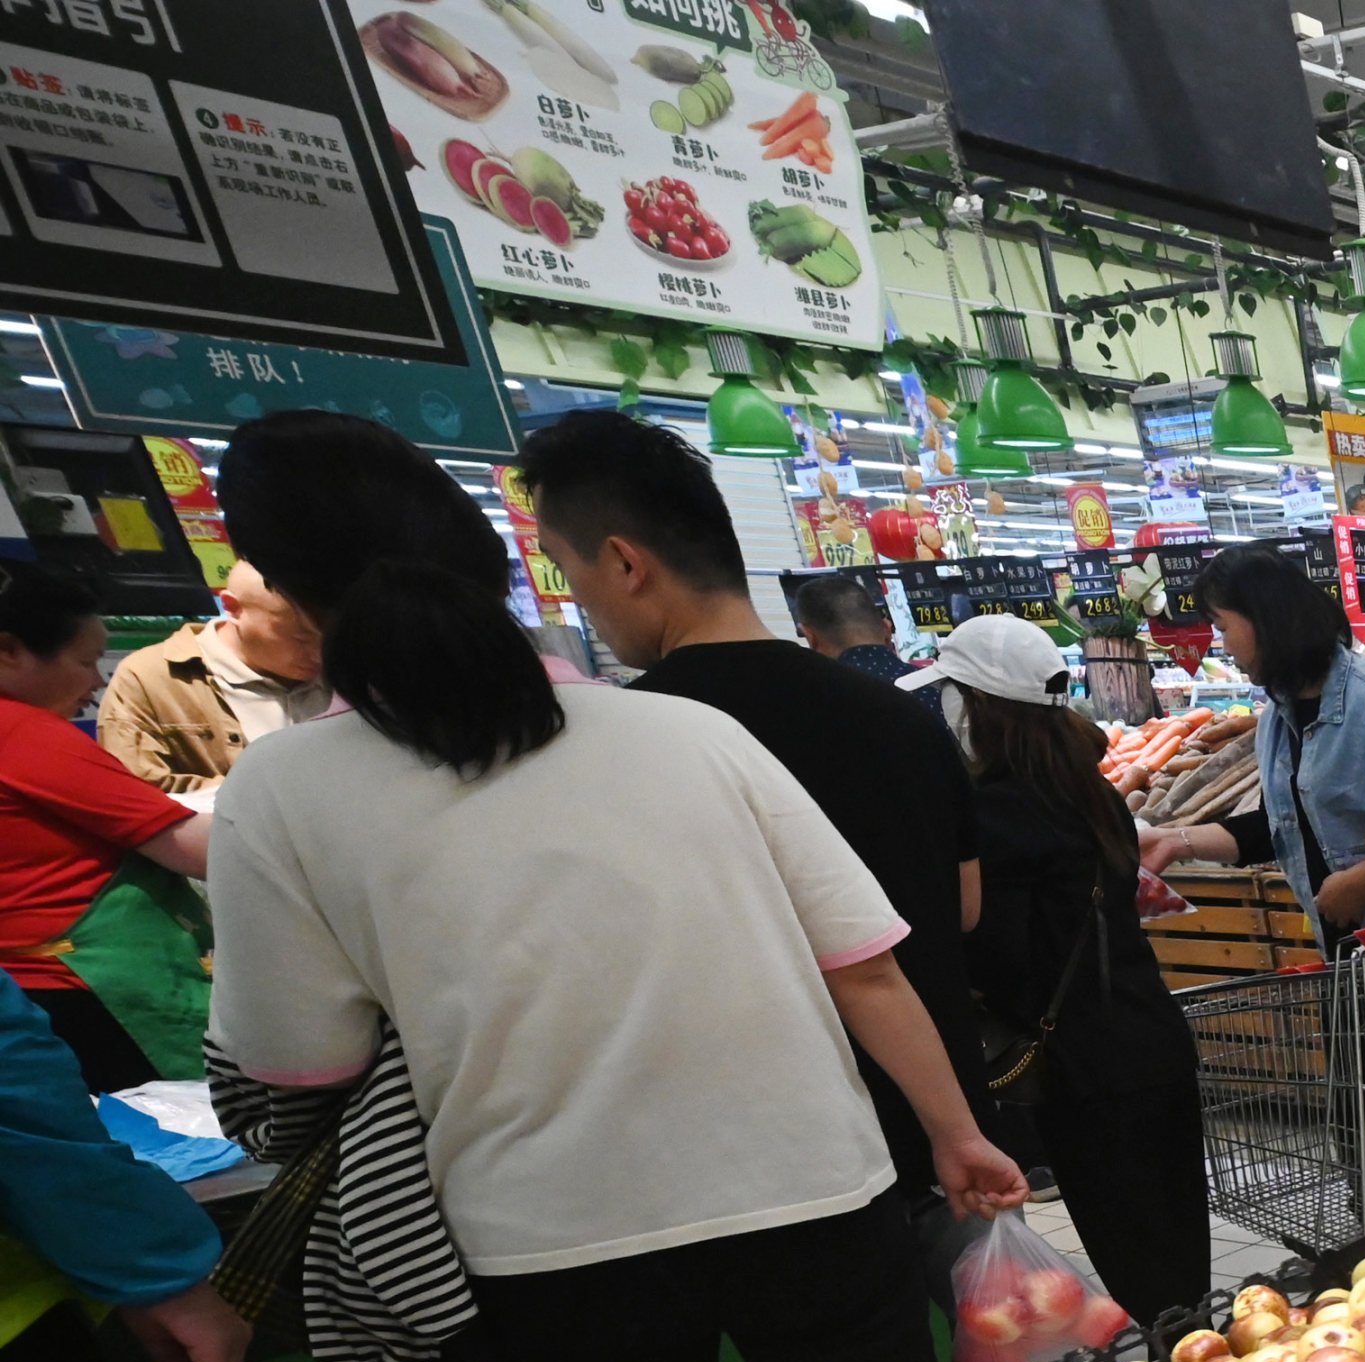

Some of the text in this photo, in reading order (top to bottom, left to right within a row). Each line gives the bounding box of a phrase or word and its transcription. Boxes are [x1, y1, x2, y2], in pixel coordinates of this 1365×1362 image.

[537, 93, 590, 122] 白萝卜
[671, 134, 720, 162] 青萝卜
[781, 166, 825, 190] 胡萝卜
[500, 243, 574, 272] 红心萝卜
[658, 272, 722, 298] 樱桃萝卜
